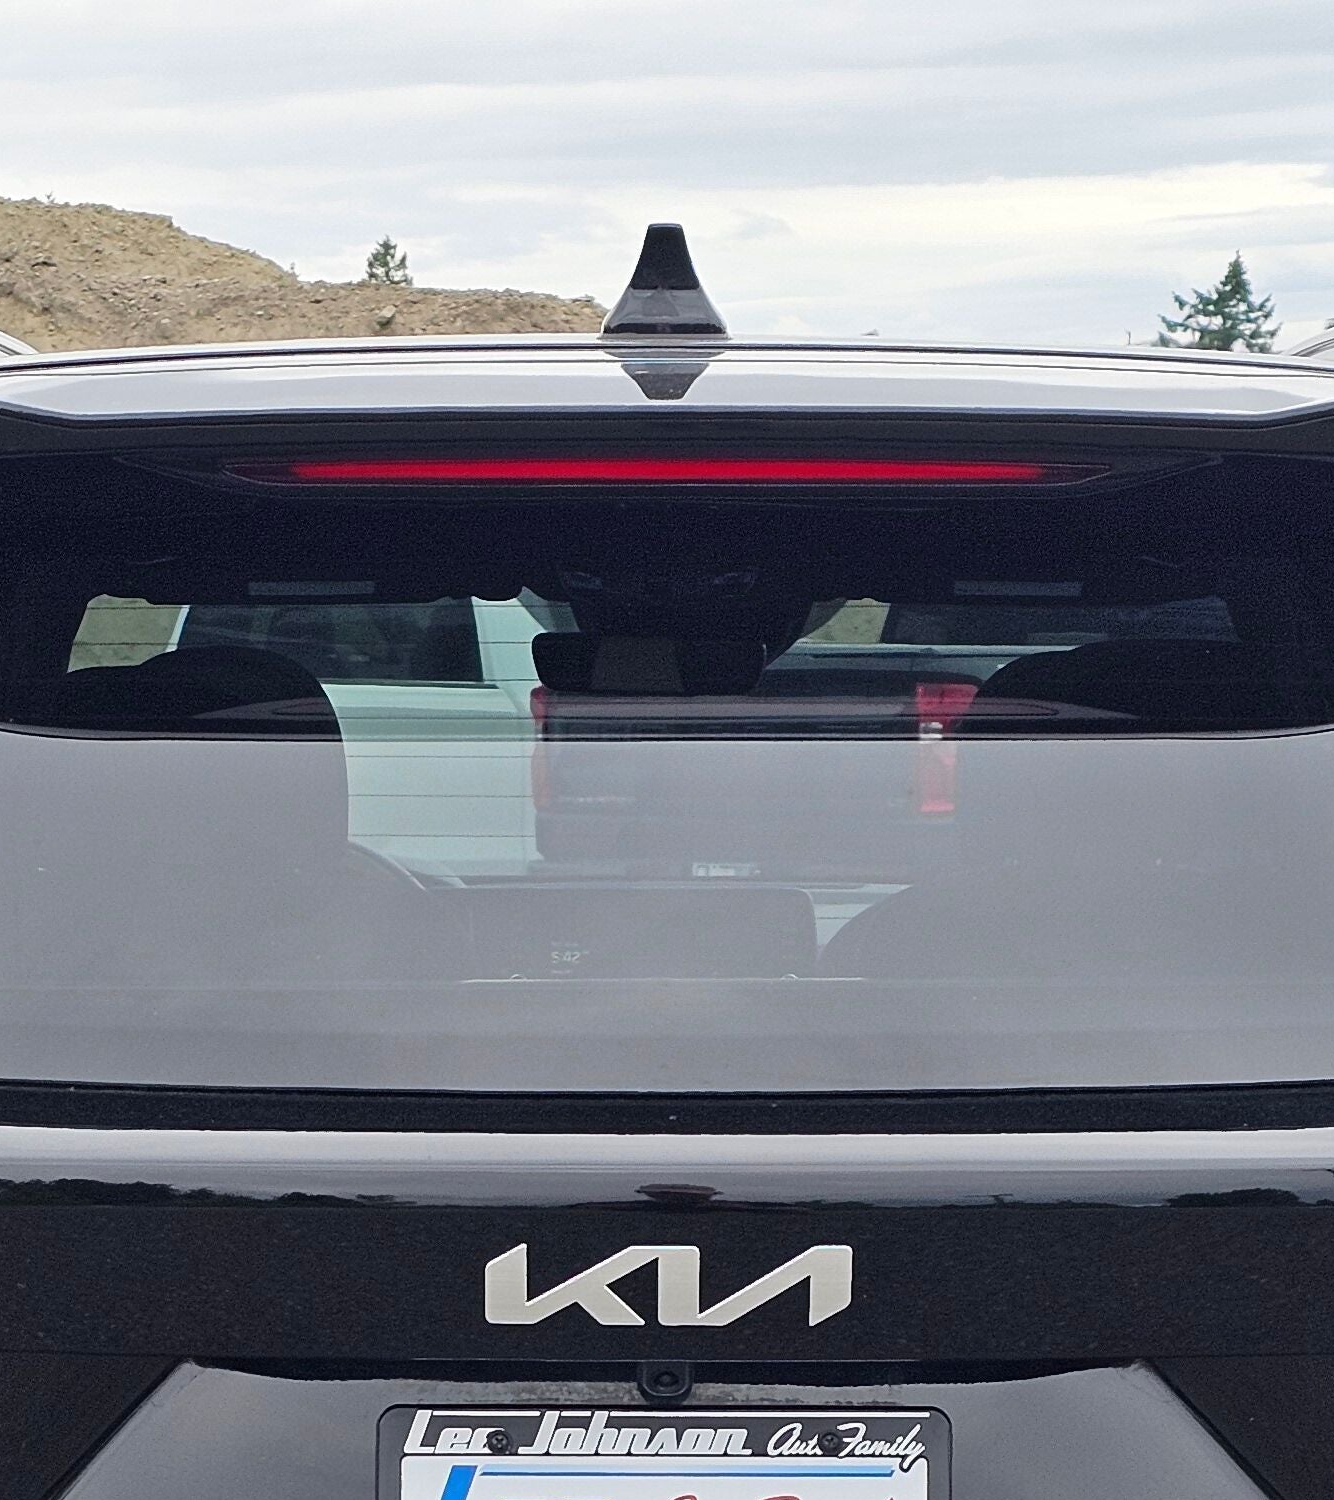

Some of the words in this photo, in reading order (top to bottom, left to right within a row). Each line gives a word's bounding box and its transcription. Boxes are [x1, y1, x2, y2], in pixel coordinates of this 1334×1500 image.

[484, 1243, 853, 1326] KIA
[517, 1410, 752, 1455] Johnson
[767, 1422, 825, 1457] Aut
[836, 1422, 926, 1471] Family
